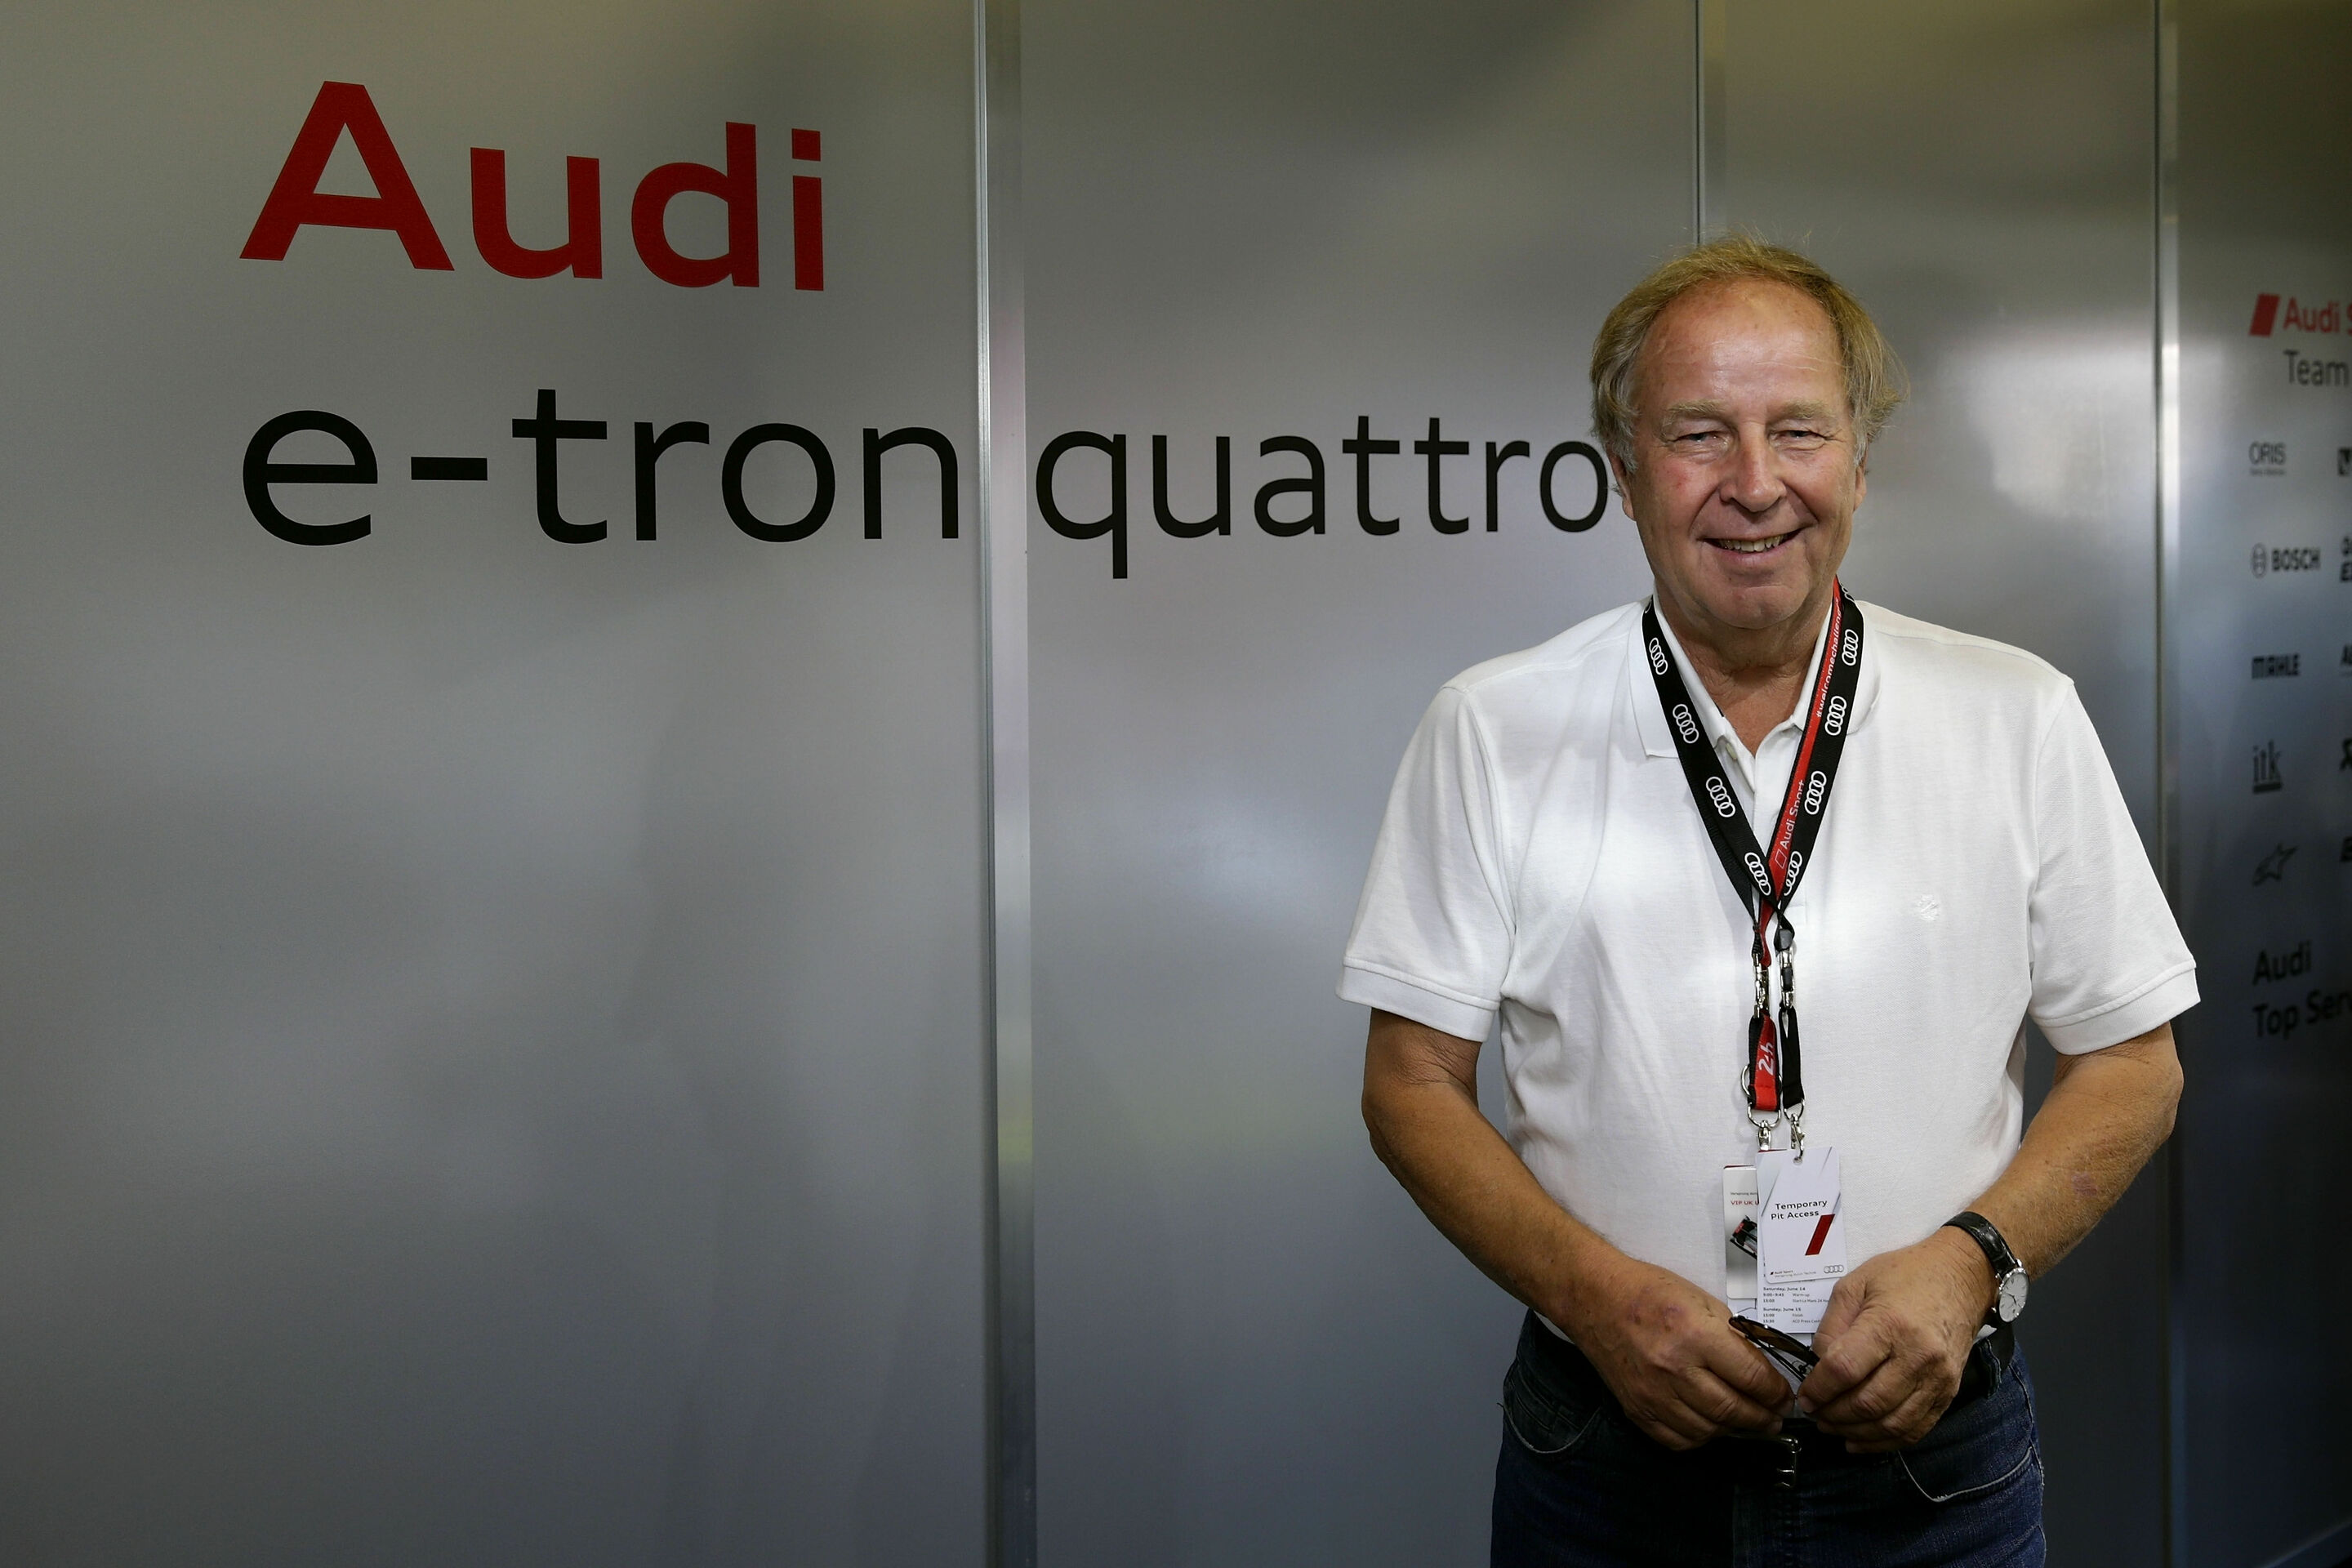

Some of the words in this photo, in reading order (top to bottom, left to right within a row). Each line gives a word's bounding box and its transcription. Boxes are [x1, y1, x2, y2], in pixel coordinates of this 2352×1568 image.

[239, 80, 825, 292] Audi
[2283, 296, 2341, 334] Audi
[2283, 349, 2350, 387] Team
[2248, 440, 2287, 466] ORIS
[243, 389, 960, 546] e-tron
[1036, 416, 1609, 580] quattro
[2271, 547, 2321, 572] BOSCH
[2252, 653, 2300, 679] MAHLE
[1780, 819, 1795, 850] Audi
[2252, 940, 2312, 987] Audi
[2252, 1001, 2299, 1040] Top
[1775, 1200, 1828, 1210] Temporary
[1787, 1210, 1820, 1219] Access
